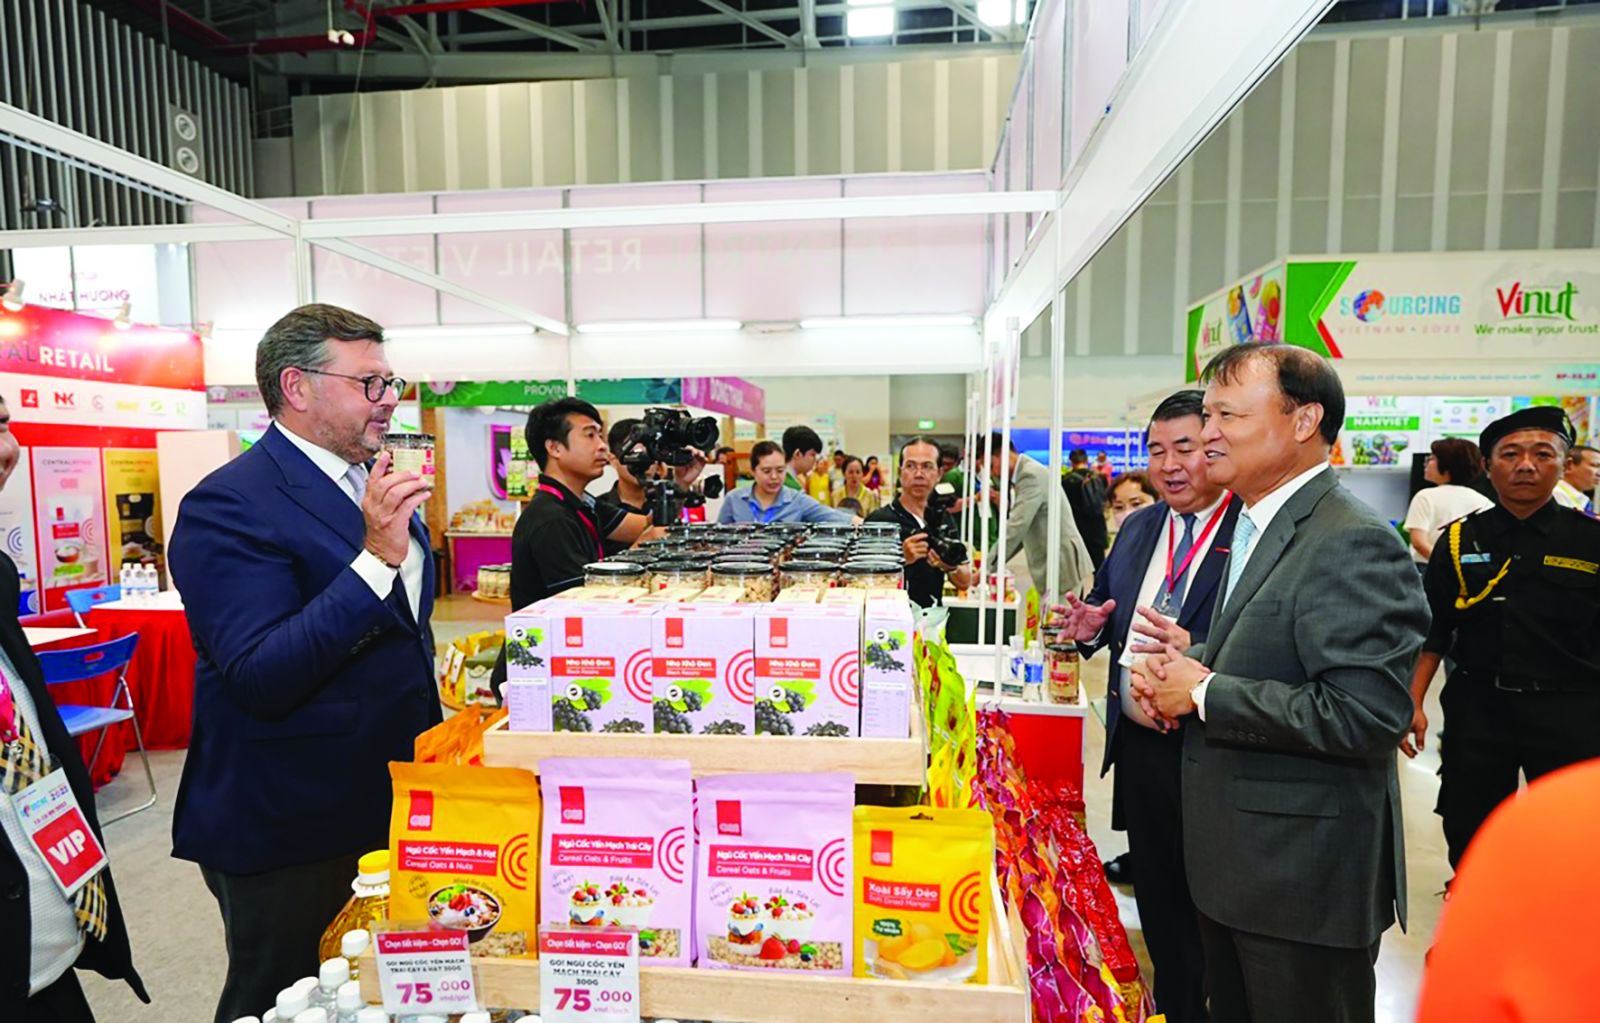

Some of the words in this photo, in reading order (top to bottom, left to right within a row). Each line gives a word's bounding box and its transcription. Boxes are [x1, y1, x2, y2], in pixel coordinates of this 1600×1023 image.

[1496, 281, 1579, 321] Vinut
[1474, 324, 1494, 335] We
[1497, 324, 1533, 335] make
[1536, 326, 1564, 336] your
[1568, 324, 1599, 334] trust
[524, 384, 581, 398] PROVINE
[48, 829, 87, 866] VIP
[584, 854, 601, 862] Oats
[741, 865, 760, 874] Oats
[869, 882, 891, 894] Xoài
[894, 886, 912, 898] Sấy
[576, 978, 599, 986] 300G
[396, 982, 433, 1004] 75
[554, 988, 592, 1012] 75
